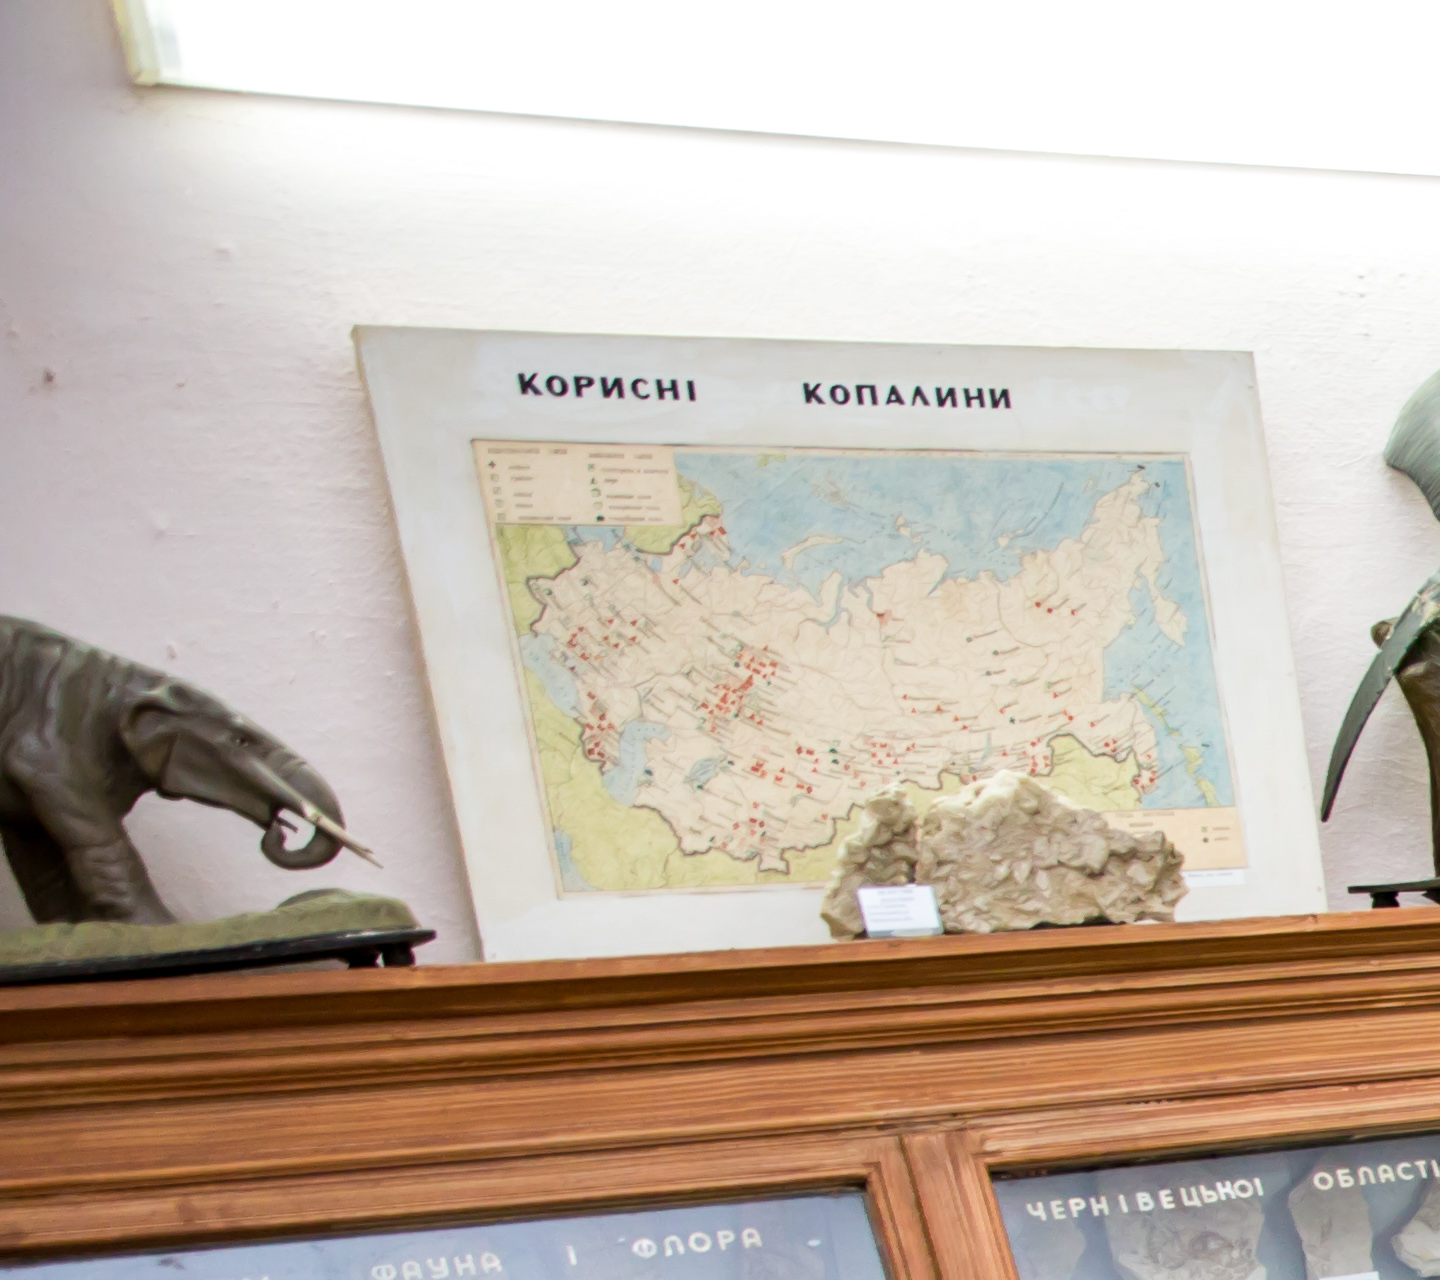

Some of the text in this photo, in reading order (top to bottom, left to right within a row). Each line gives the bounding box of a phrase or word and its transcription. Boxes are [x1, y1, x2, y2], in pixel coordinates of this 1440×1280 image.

[516, 371, 1013, 409] КОРИСНІ КОПАЛИНИ
[631, 1227, 763, 1260] ФЛОРА
